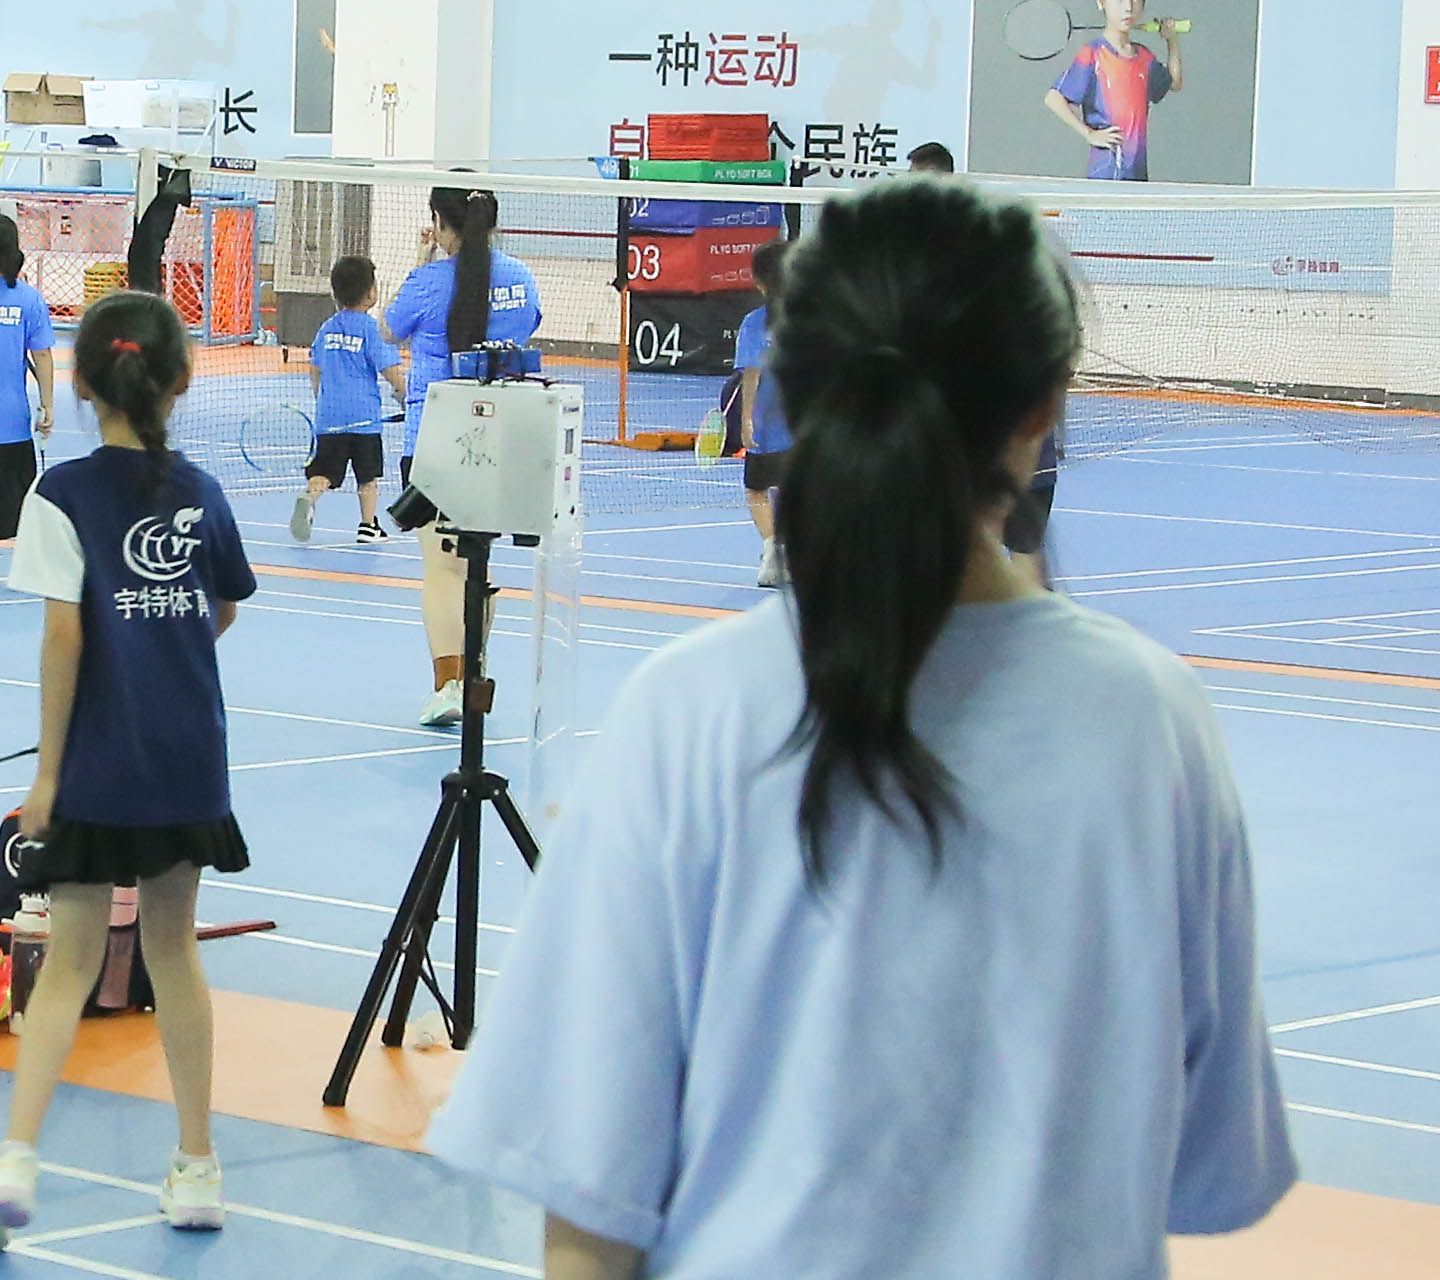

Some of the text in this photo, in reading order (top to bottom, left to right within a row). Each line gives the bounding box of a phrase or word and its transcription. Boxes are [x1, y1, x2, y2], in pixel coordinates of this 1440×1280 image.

[609, 31, 798, 88] 一种运动
[491, 299, 527, 312] SPORT
[635, 320, 683, 366] 04
[114, 585, 210, 620] 宇特体育
